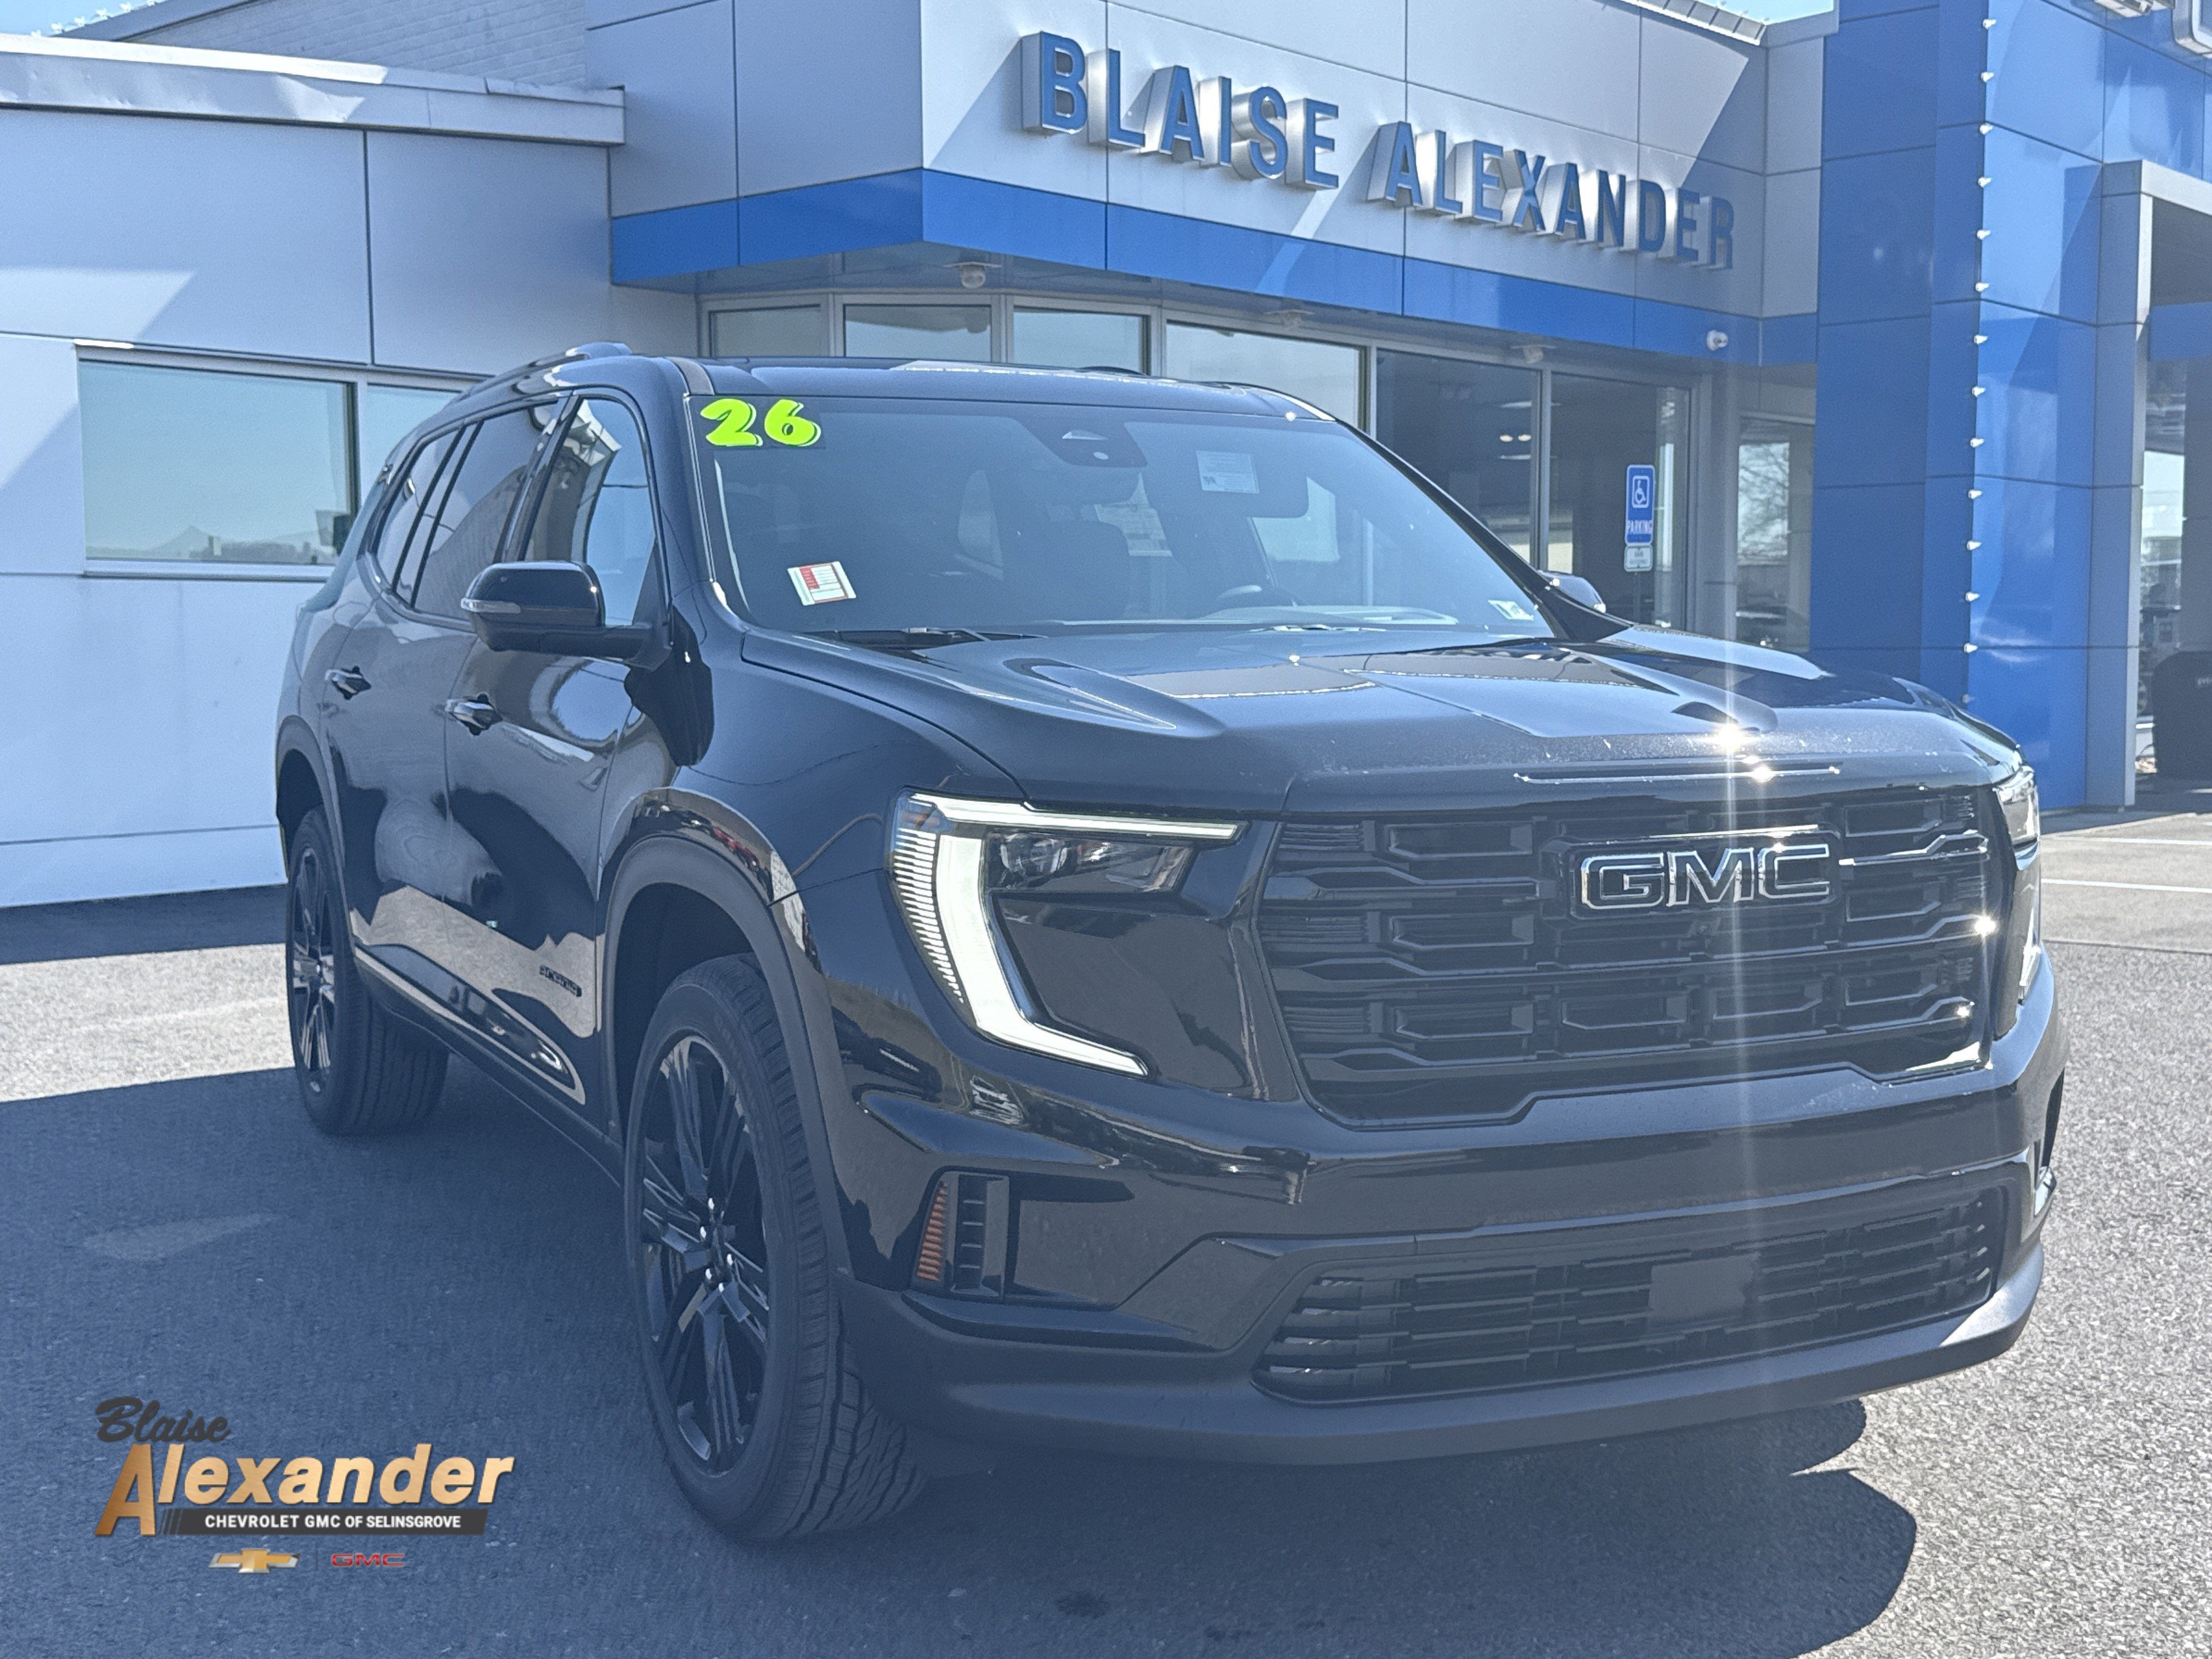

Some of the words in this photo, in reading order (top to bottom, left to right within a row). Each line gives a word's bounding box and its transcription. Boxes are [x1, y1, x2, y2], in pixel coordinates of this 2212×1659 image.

[1032, 31, 1340, 189] BLAISE
[1378, 121, 1735, 269] ALEXANDER
[700, 398, 821, 447] 26
[1626, 520, 1653, 534] PARKING
[1581, 844, 1830, 909] GMC
